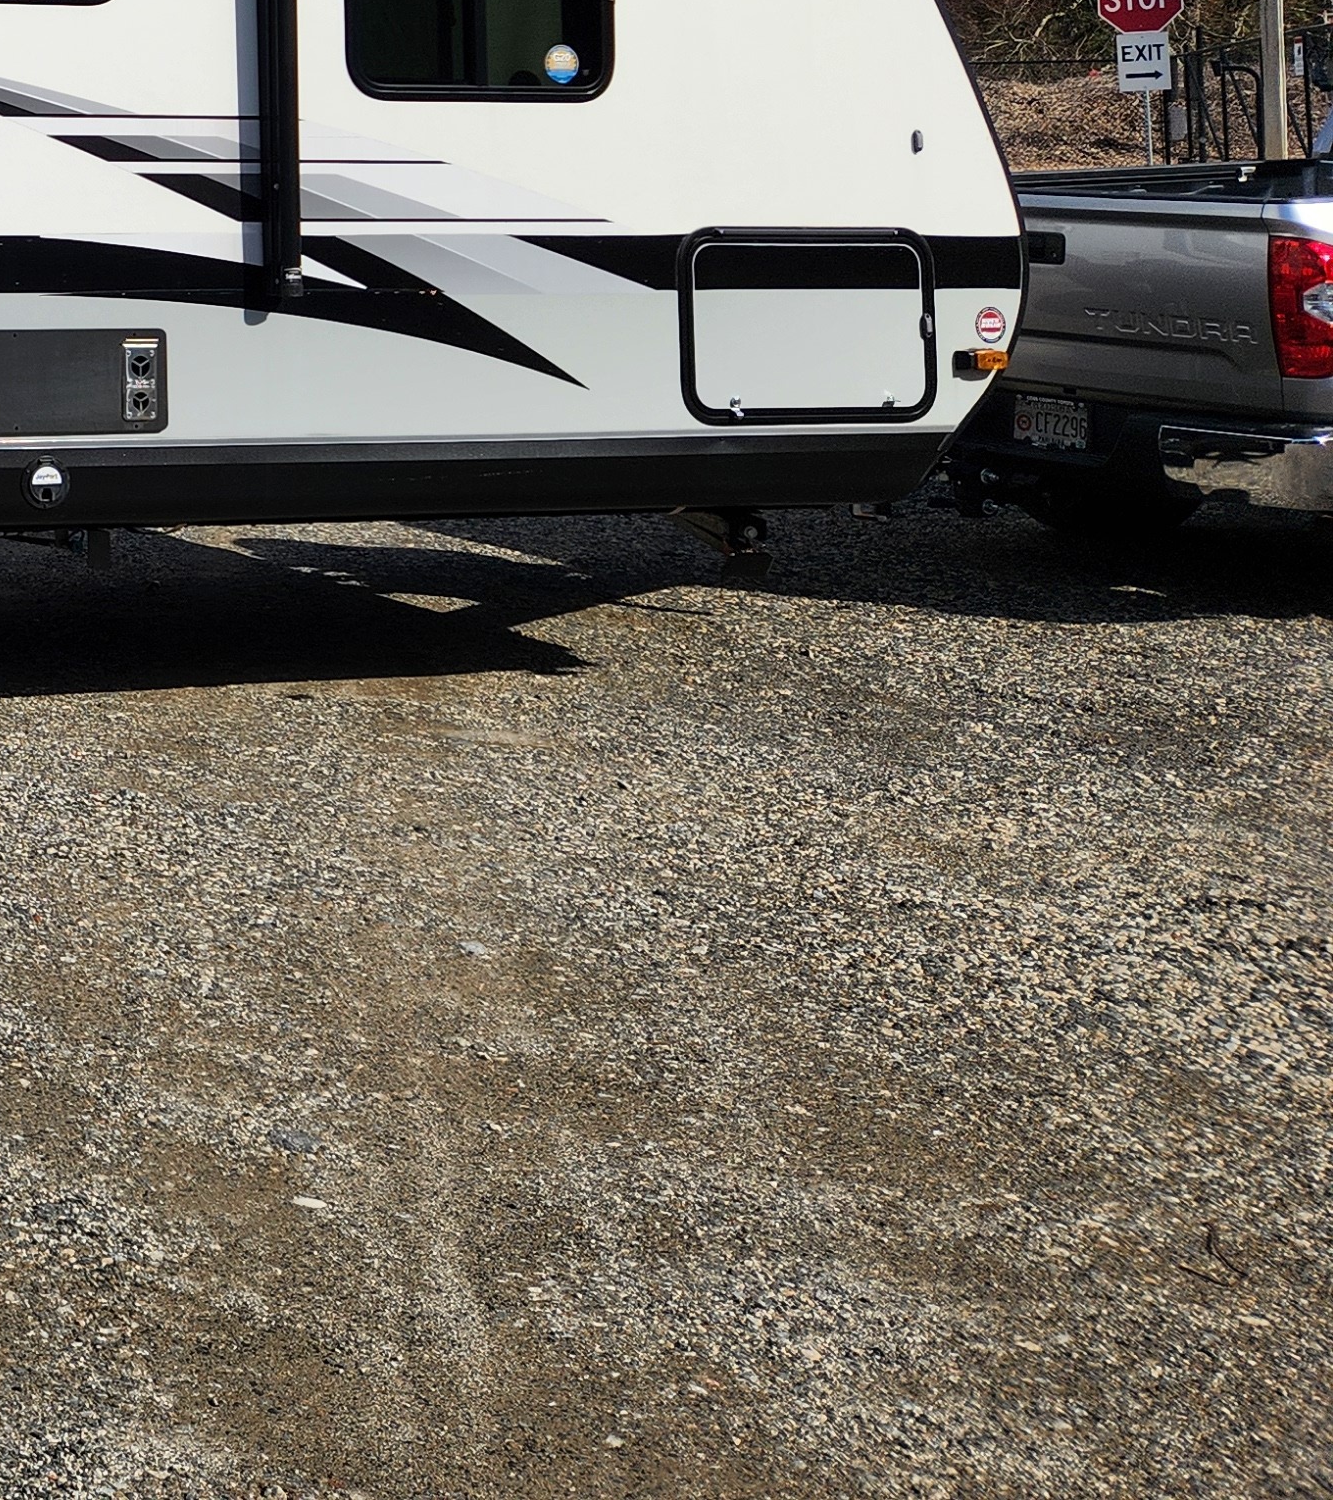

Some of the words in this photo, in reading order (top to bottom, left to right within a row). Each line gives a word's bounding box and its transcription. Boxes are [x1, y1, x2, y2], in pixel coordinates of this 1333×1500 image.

[1121, 43, 1165, 63] EXIT
[1084, 308, 1258, 344] TUNDRA
[1035, 411, 1088, 440] CF2296
